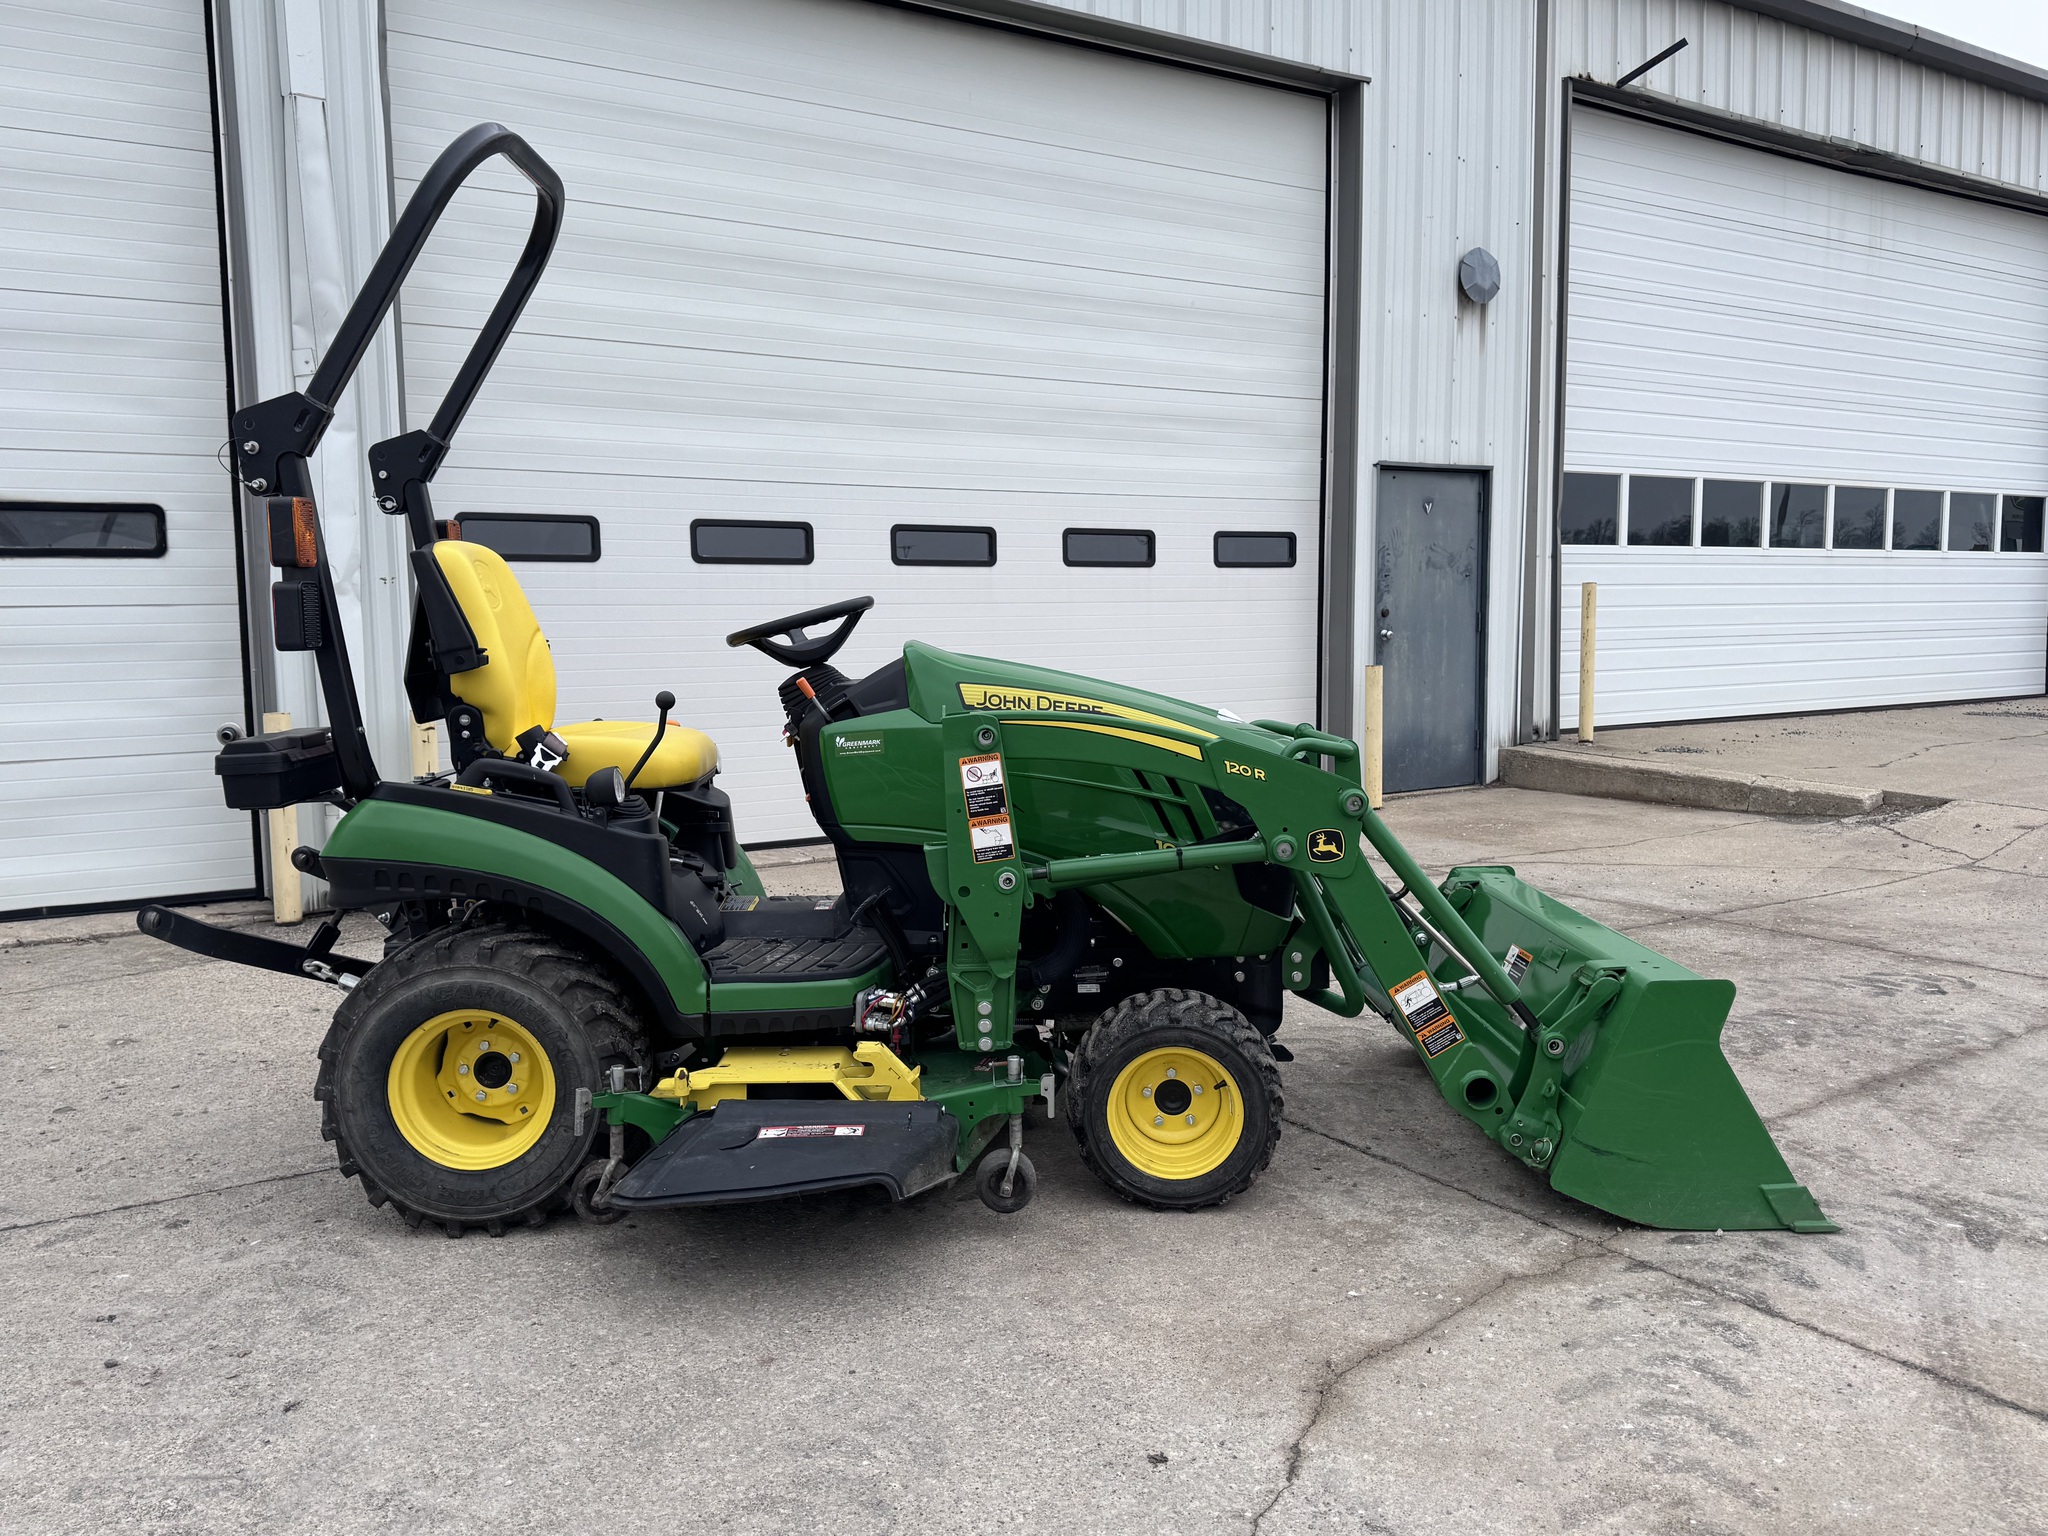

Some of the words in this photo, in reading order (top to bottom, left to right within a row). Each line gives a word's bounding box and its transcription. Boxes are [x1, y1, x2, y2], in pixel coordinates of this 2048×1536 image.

[976, 691, 1031, 710] JOHN
[842, 739, 881, 748] GREENMARK
[968, 754, 999, 764] WARNING
[976, 816, 1008, 827] WARNING
[1400, 974, 1423, 990] WARNING
